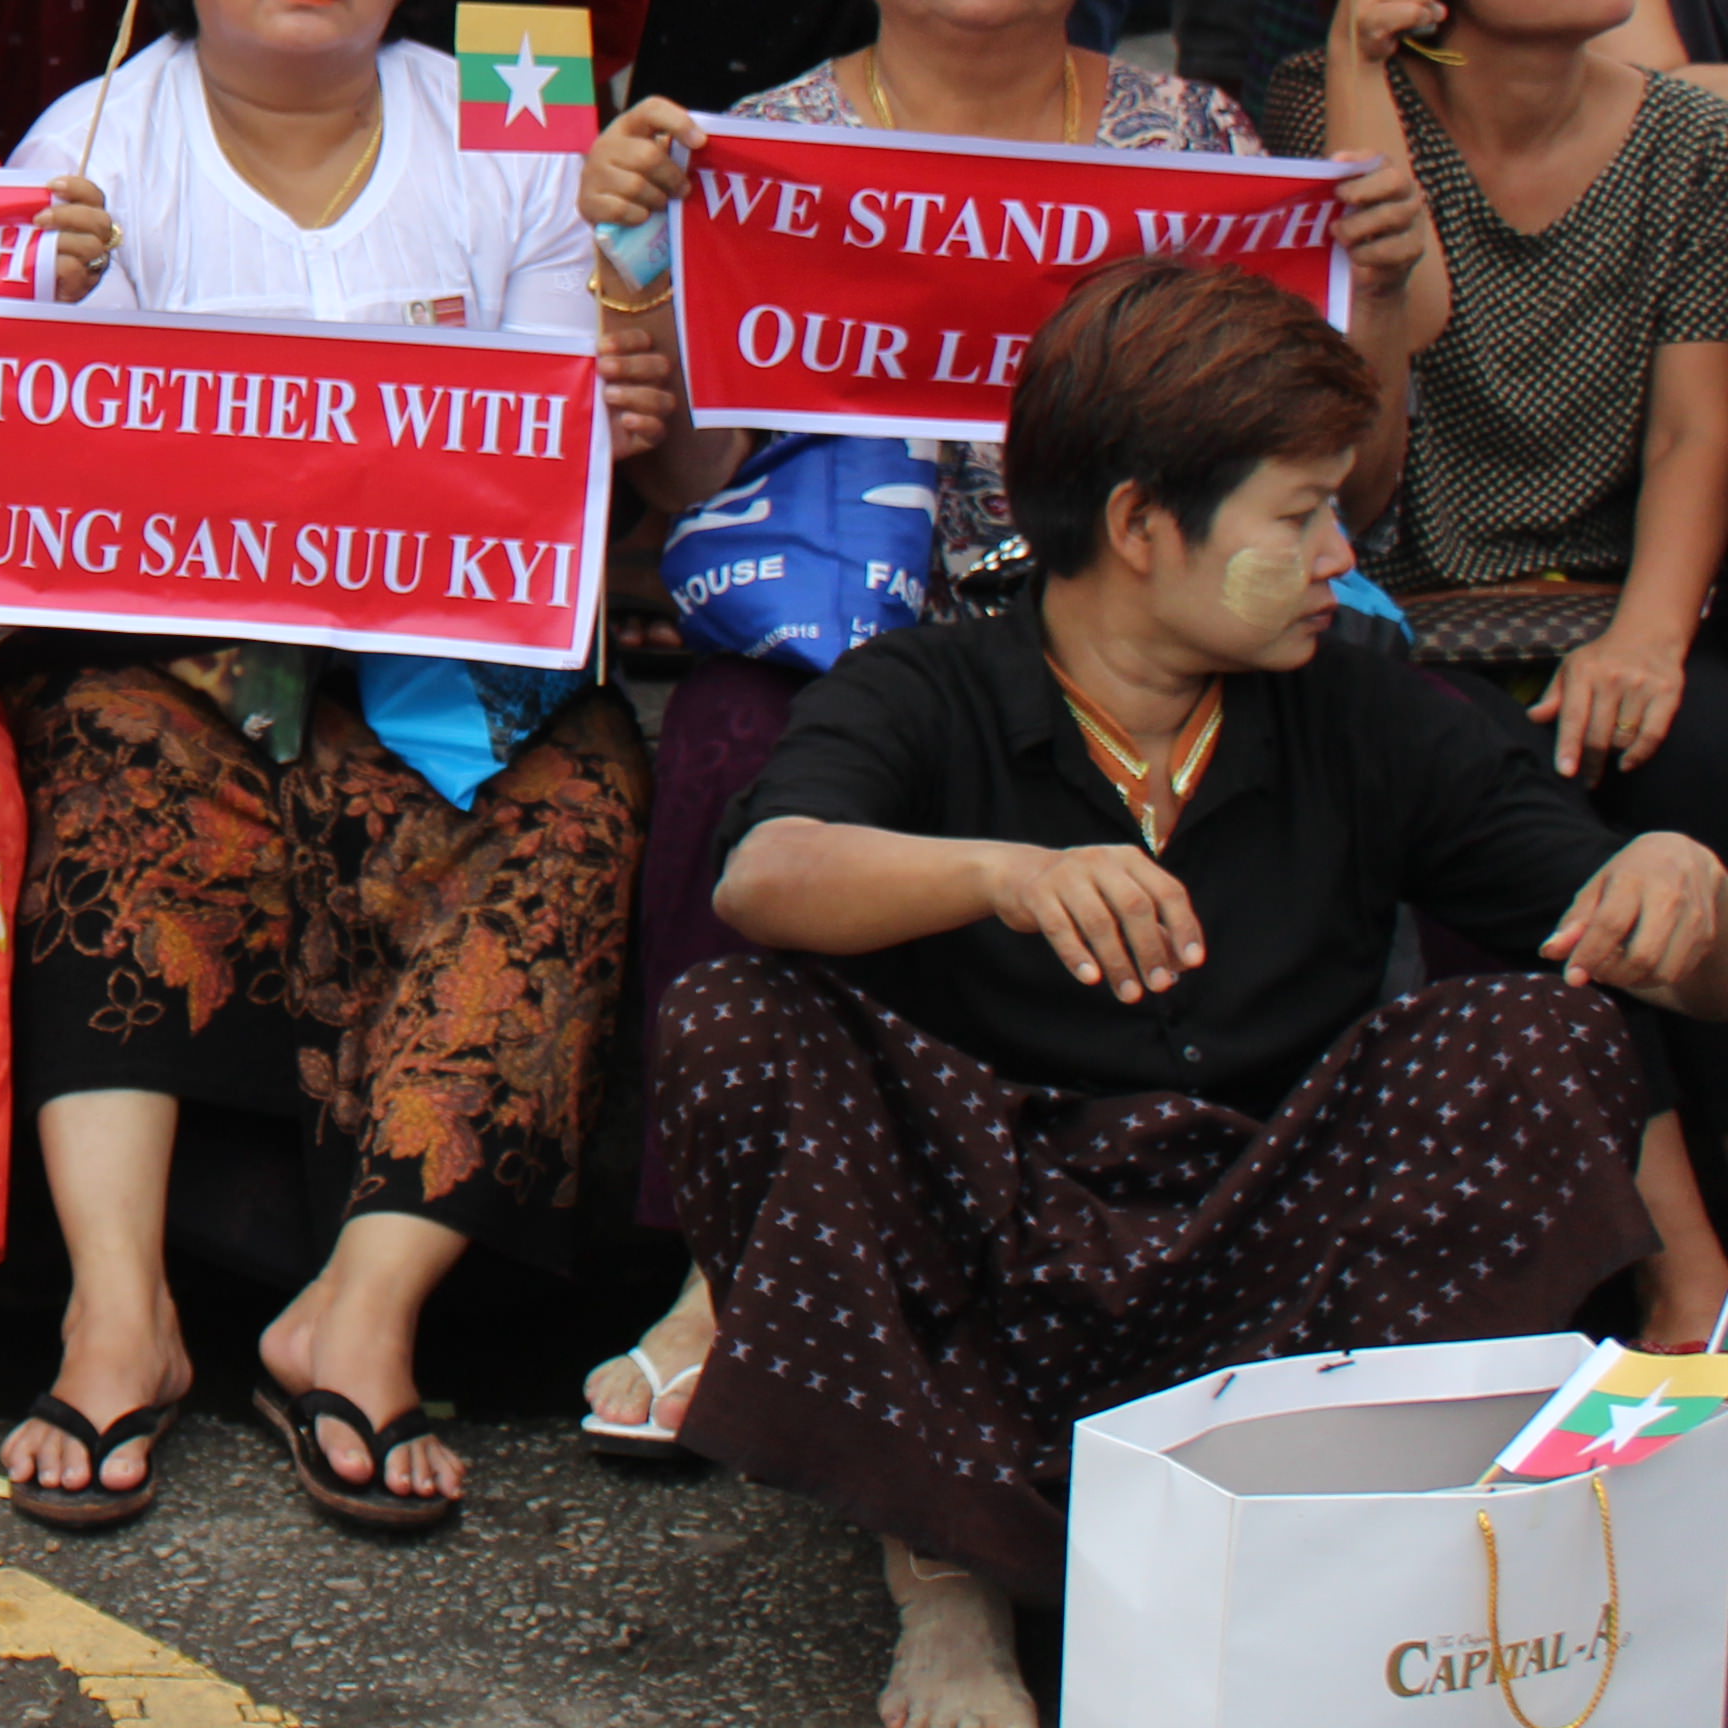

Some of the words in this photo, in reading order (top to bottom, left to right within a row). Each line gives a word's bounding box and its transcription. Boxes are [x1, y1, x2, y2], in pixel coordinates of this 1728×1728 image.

[701, 171, 822, 237] WE
[845, 190, 1109, 264] STAND
[1135, 202, 1335, 258] WITH
[739, 306, 907, 378] OUR
[380, 384, 568, 458] WITH
[140, 515, 276, 581] SAN
[293, 525, 428, 593] SUU
[448, 536, 575, 608] KYI
[671, 554, 787, 615] HOUSE
